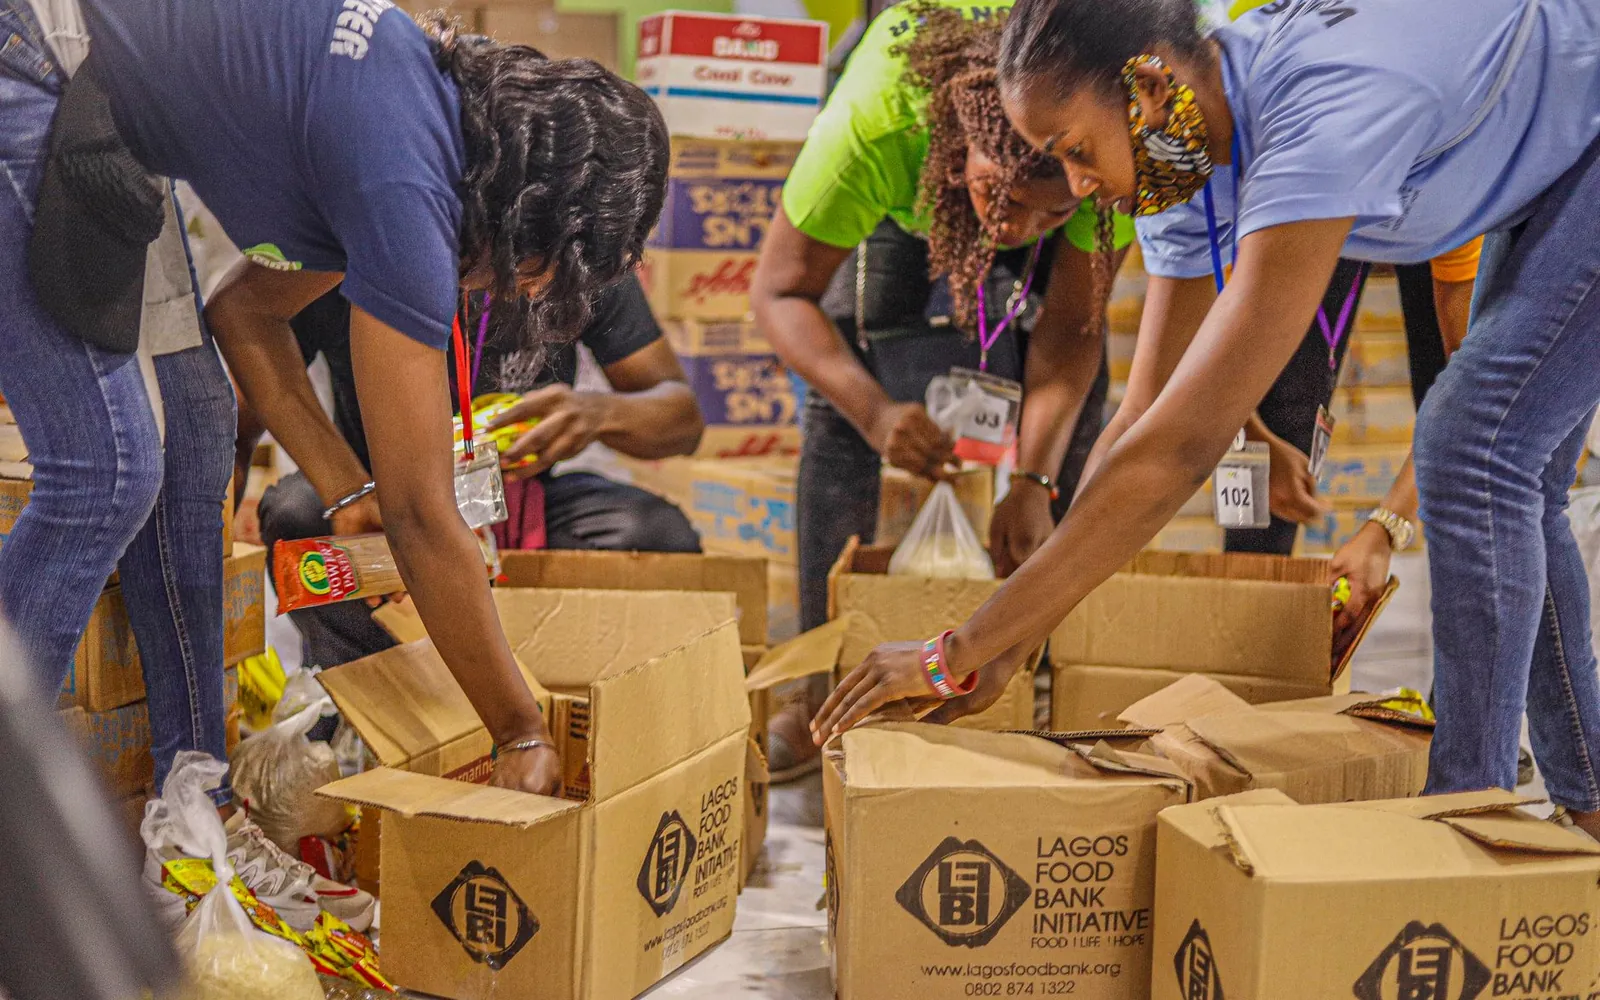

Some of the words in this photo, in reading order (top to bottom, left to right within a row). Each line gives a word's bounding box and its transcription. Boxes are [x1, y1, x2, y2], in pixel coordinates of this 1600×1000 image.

[1221, 486, 1250, 506] 102
[320, 547, 344, 598] POWER
[701, 776, 738, 814] LAGOS
[699, 804, 731, 838] FOOD
[697, 828, 727, 861] BANK
[1036, 835, 1129, 859] LAGOS
[695, 840, 738, 885] INITIATIVE
[1036, 861, 1114, 884] FOOD
[1034, 886, 1106, 910] BANK
[1033, 908, 1150, 934] INITIATIVE
[1500, 912, 1590, 941] LAGOS
[1031, 936, 1068, 949] FOOD
[1080, 935, 1101, 948] LIFE
[1114, 933, 1145, 947] HOPE
[1496, 942, 1575, 969] FOOD
[921, 961, 1121, 978] www.lagosfoodbank.org
[964, 981, 1002, 996] 0802
[1006, 980, 1034, 996] 874
[1040, 980, 1076, 995] 1322
[1492, 969, 1564, 997] BANK
